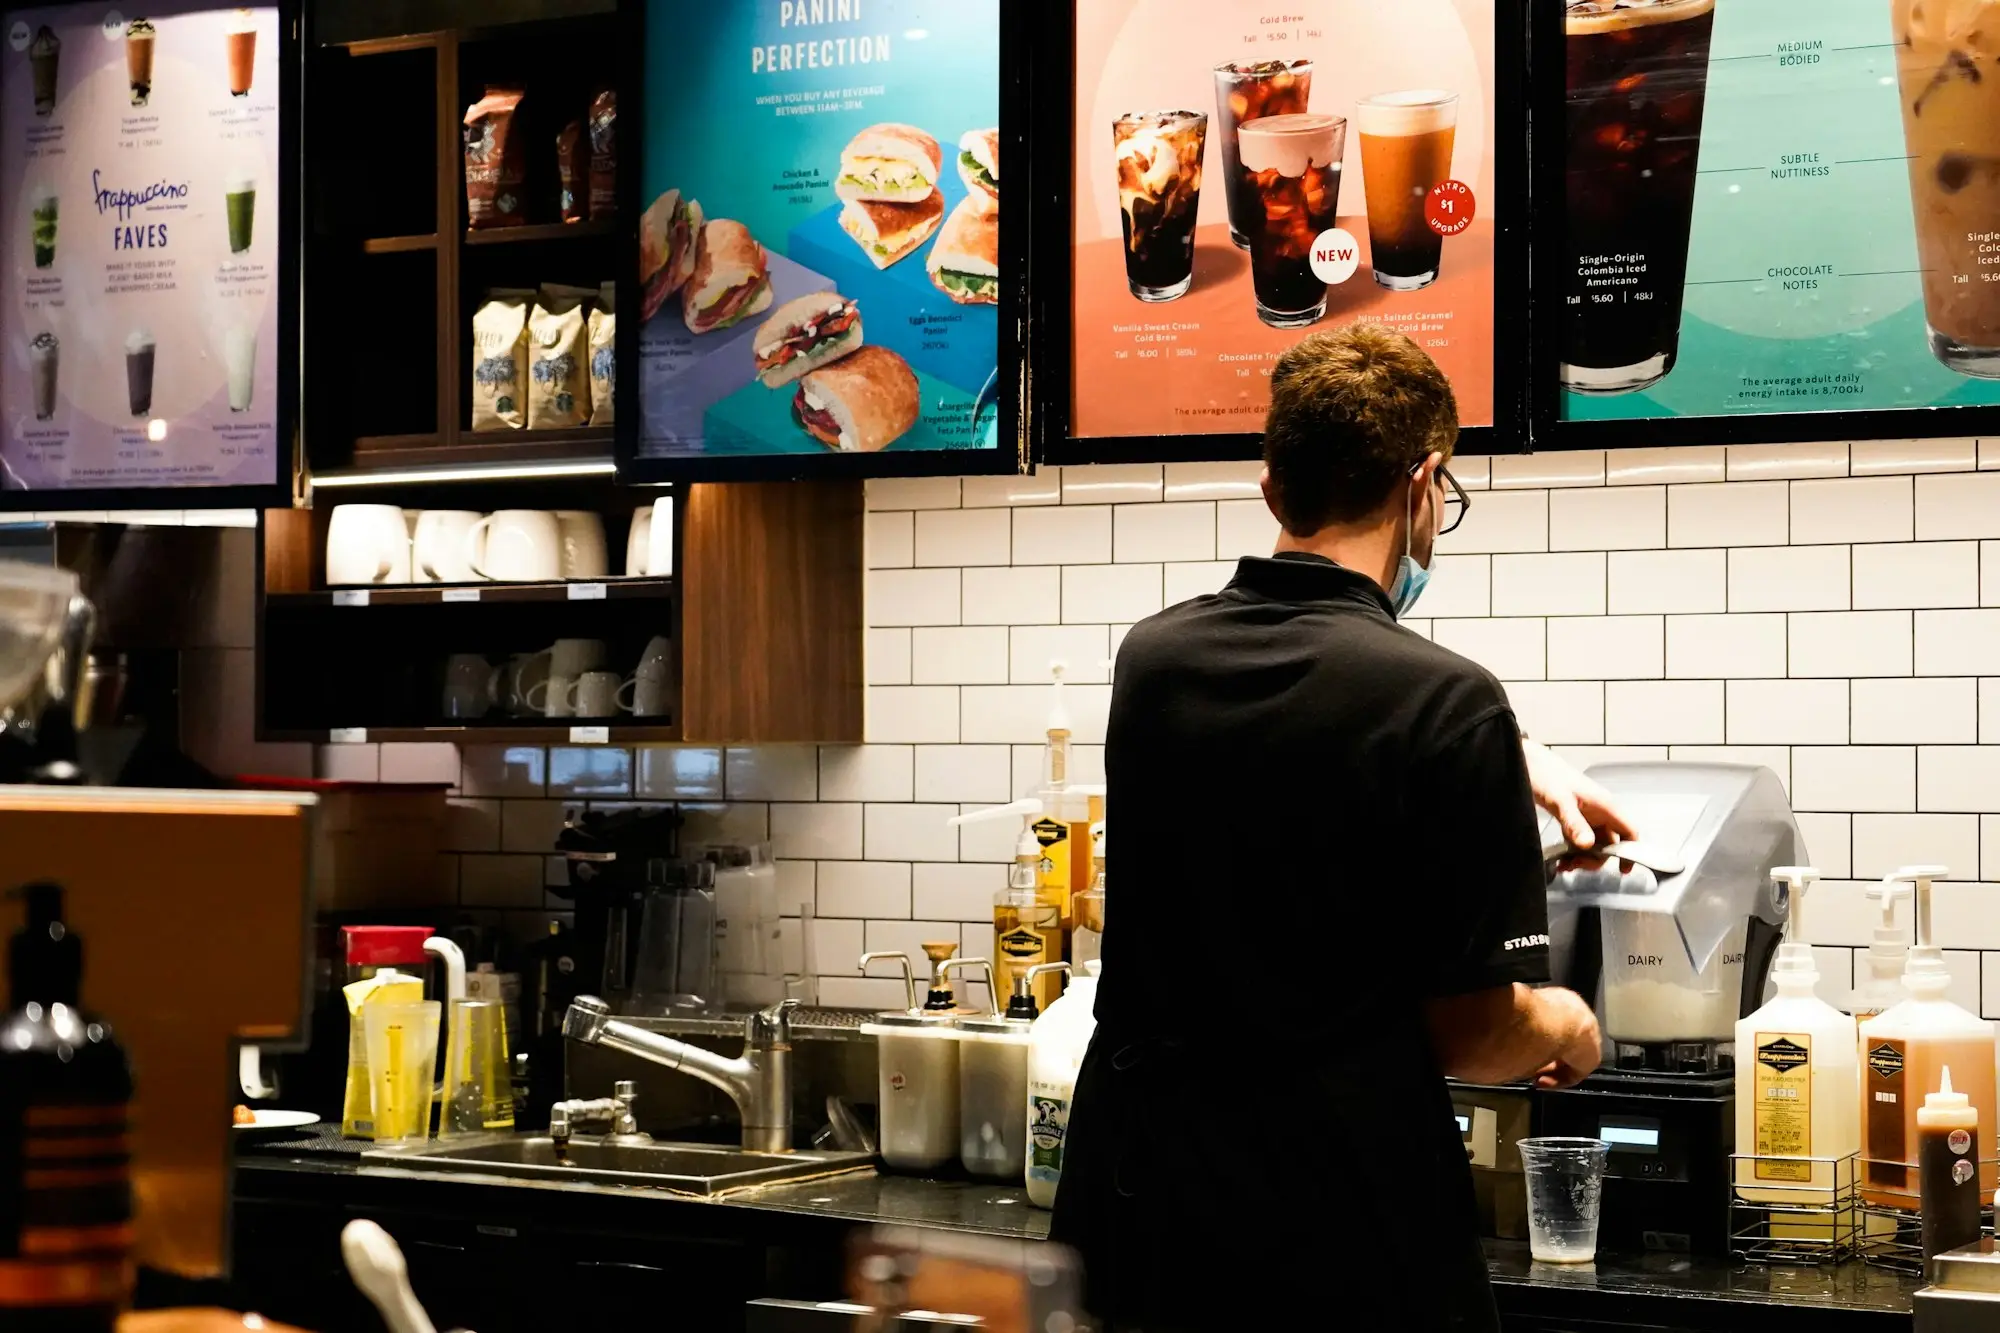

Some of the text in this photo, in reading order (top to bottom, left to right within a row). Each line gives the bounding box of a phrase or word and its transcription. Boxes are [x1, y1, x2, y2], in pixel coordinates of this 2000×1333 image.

[780, 0, 861, 27] PANINI
[1260, 15, 1304, 24] Cold Brew
[1244, 35, 1257, 43] Tall
[1777, 40, 1823, 52] MEDIUM
[752, 35, 890, 73] PERFECTION
[1780, 54, 1820, 66] BODIED
[756, 85, 886, 105] WHEN YOU BUY ANY BEVERAGE
[776, 104, 815, 116] BETWEEN
[1781, 153, 1819, 164] SUBTLE
[1771, 166, 1830, 179] NUTTINESS
[805, 180, 829, 188] Panini
[1434, 182, 1466, 196] NITRO
[93, 169, 188, 221] frappuccino
[1441, 199, 1453, 213] $1
[1430, 216, 1469, 233] UPGRADE
[114, 224, 167, 250] FAVES
[1316, 248, 1353, 262] NEW
[1579, 253, 1645, 265] Single-Origin
[1977, 255, 2000, 265] Iced
[158, 259, 176, 267] WITH
[1578, 263, 1647, 276] Colombia Iced
[1767, 264, 1833, 277] CHOCOLATE
[1586, 276, 1639, 286] Americano
[1952, 273, 2000, 283] Tall $5.6
[1783, 280, 1818, 290] NOTES
[1566, 291, 1653, 304] Tall $5.60 48kJ
[928, 315, 962, 323] Benedict
[1383, 312, 1413, 321] Salted
[1415, 311, 1453, 320] Caramel
[923, 327, 948, 335] Panini
[1113, 322, 1200, 333] Vanilla Sweet Cream
[1398, 324, 1418, 332] Cold
[1421, 323, 1444, 331] Brew
[1135, 333, 1177, 343] Cold Brew
[1115, 350, 1128, 359] Tall
[1219, 353, 1263, 362] Chocolate
[1236, 369, 1250, 377] Tall
[1742, 373, 1860, 387] The average adult daily
[1738, 385, 1864, 398] energy intake is 8,700kJ
[1174, 405, 1269, 416] The average adult dai
[923, 415, 962, 424] Vegetable
[1628, 955, 1663, 966] DAIRY
